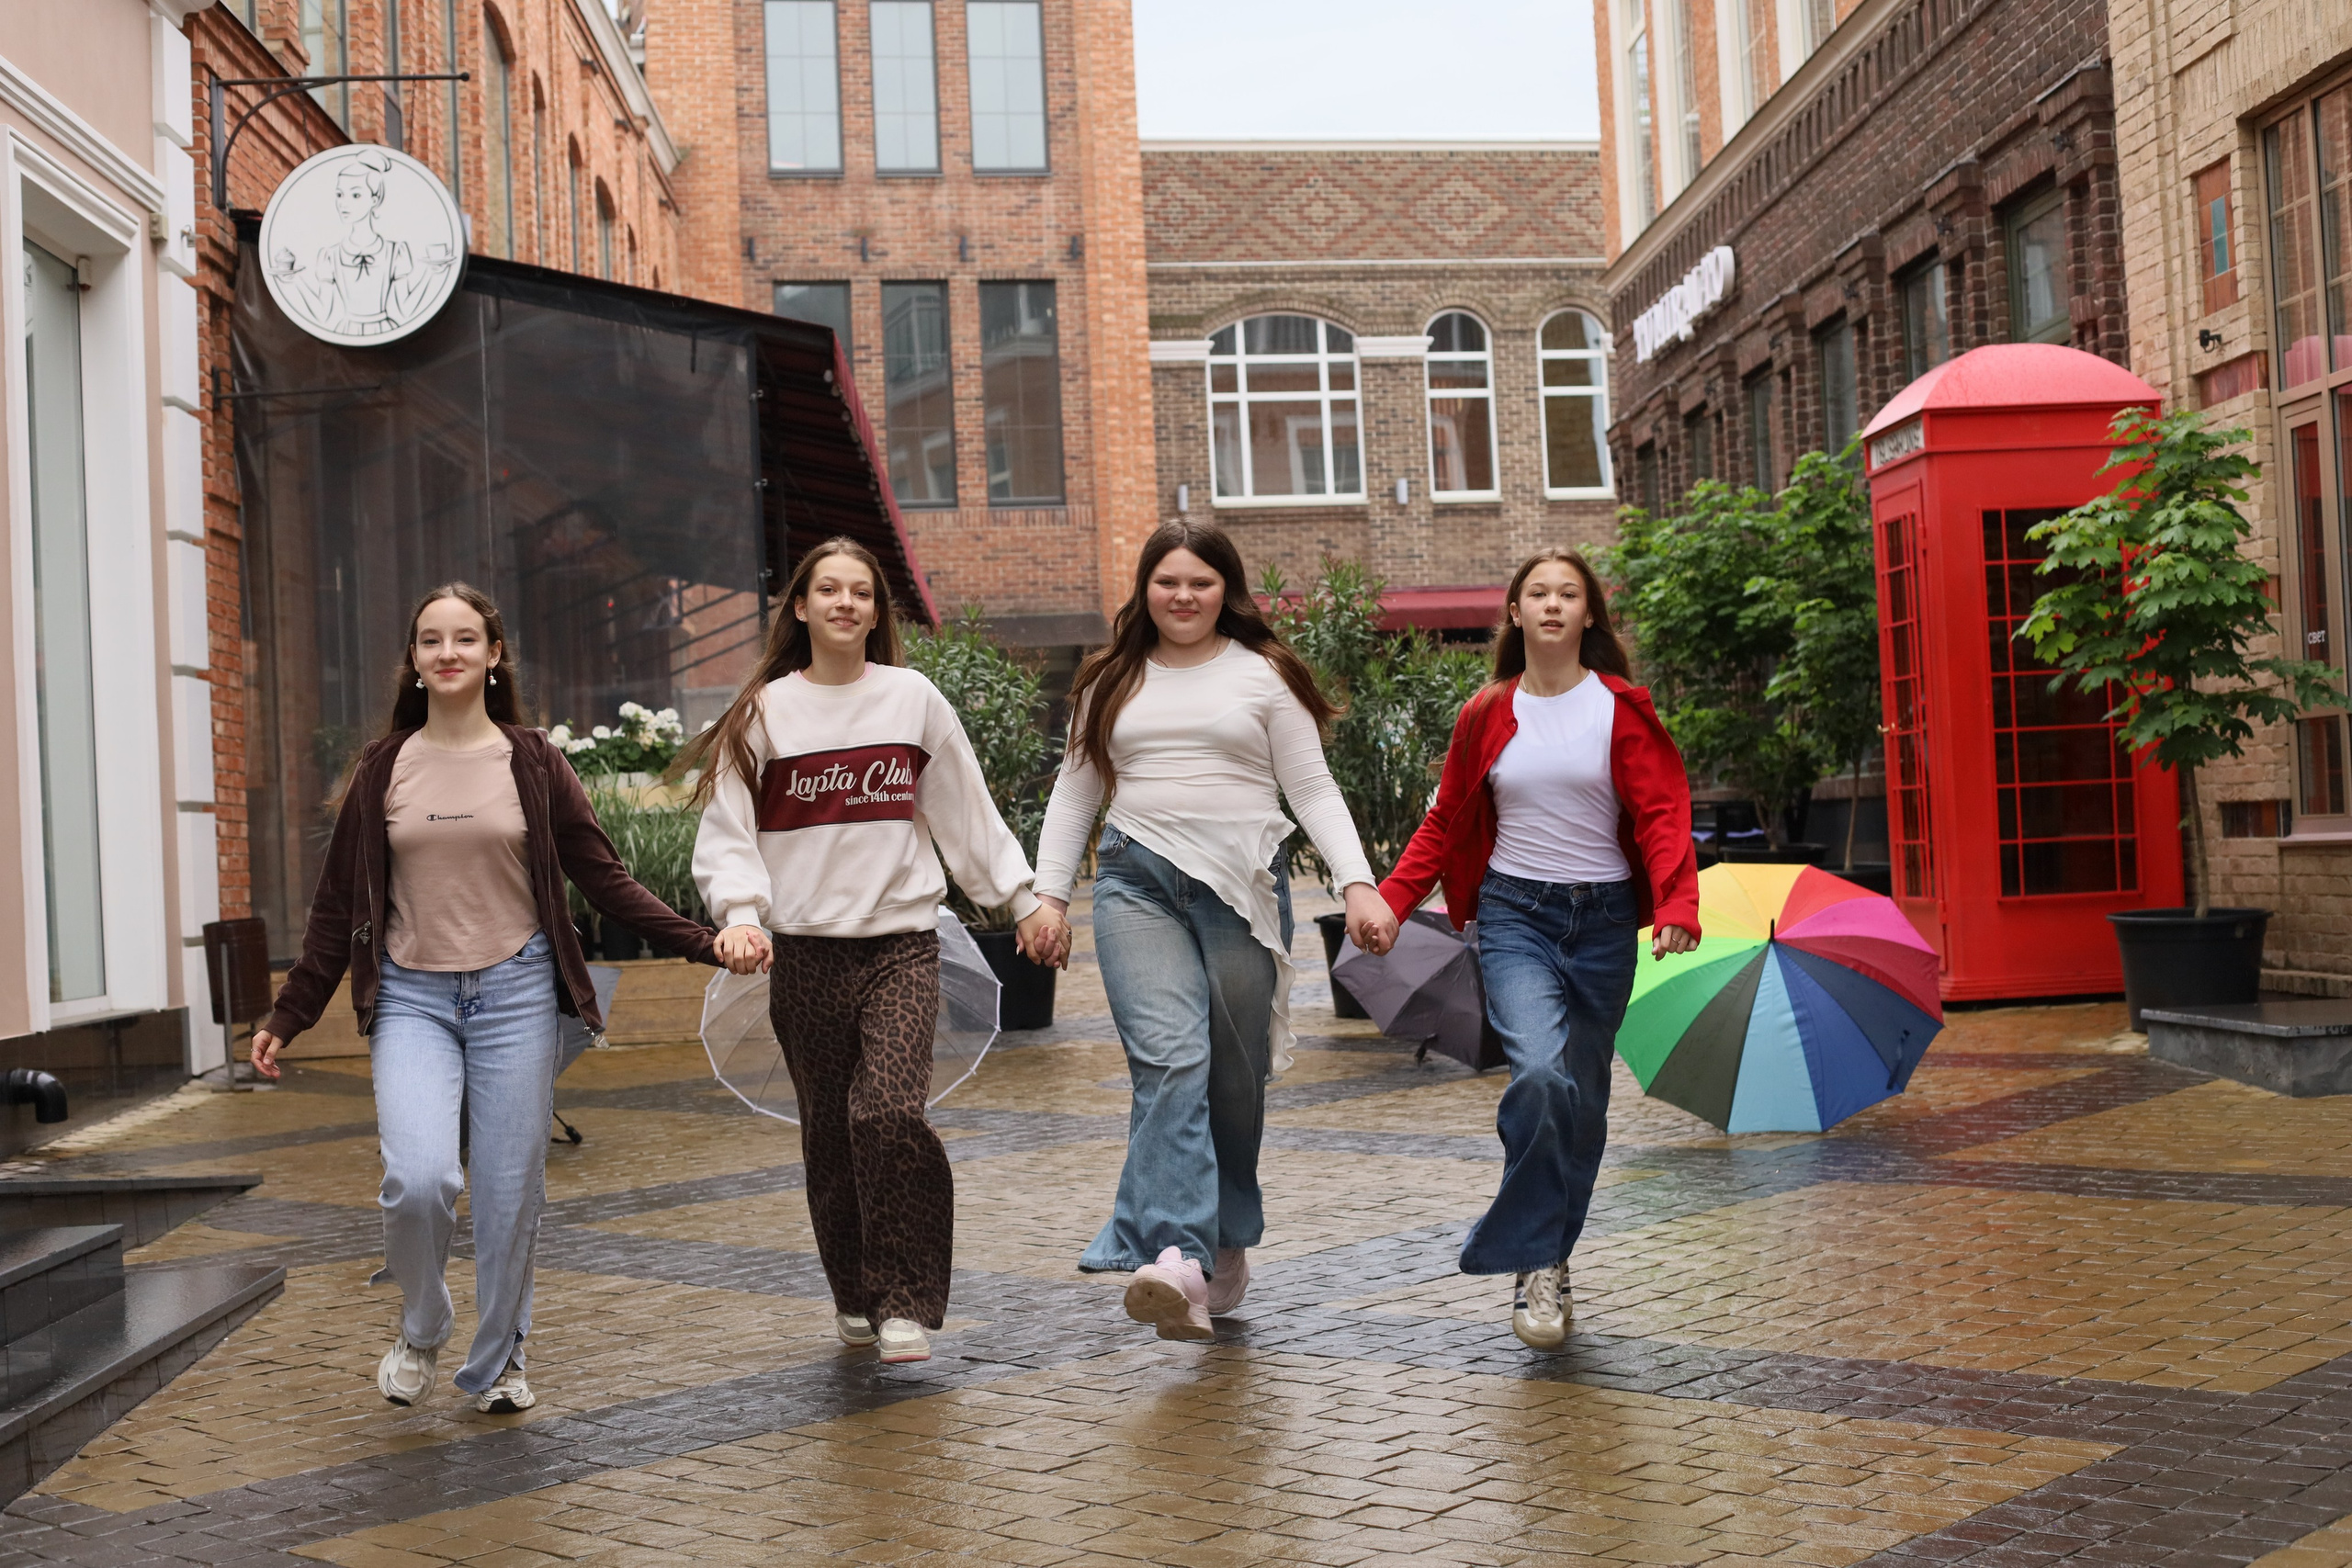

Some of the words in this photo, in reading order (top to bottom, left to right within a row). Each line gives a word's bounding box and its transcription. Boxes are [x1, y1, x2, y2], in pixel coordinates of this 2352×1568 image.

[786, 762, 857, 802] Lapta
[862, 757, 913, 795] Club
[845, 794, 869, 806] since
[870, 790, 889, 803] 14th
